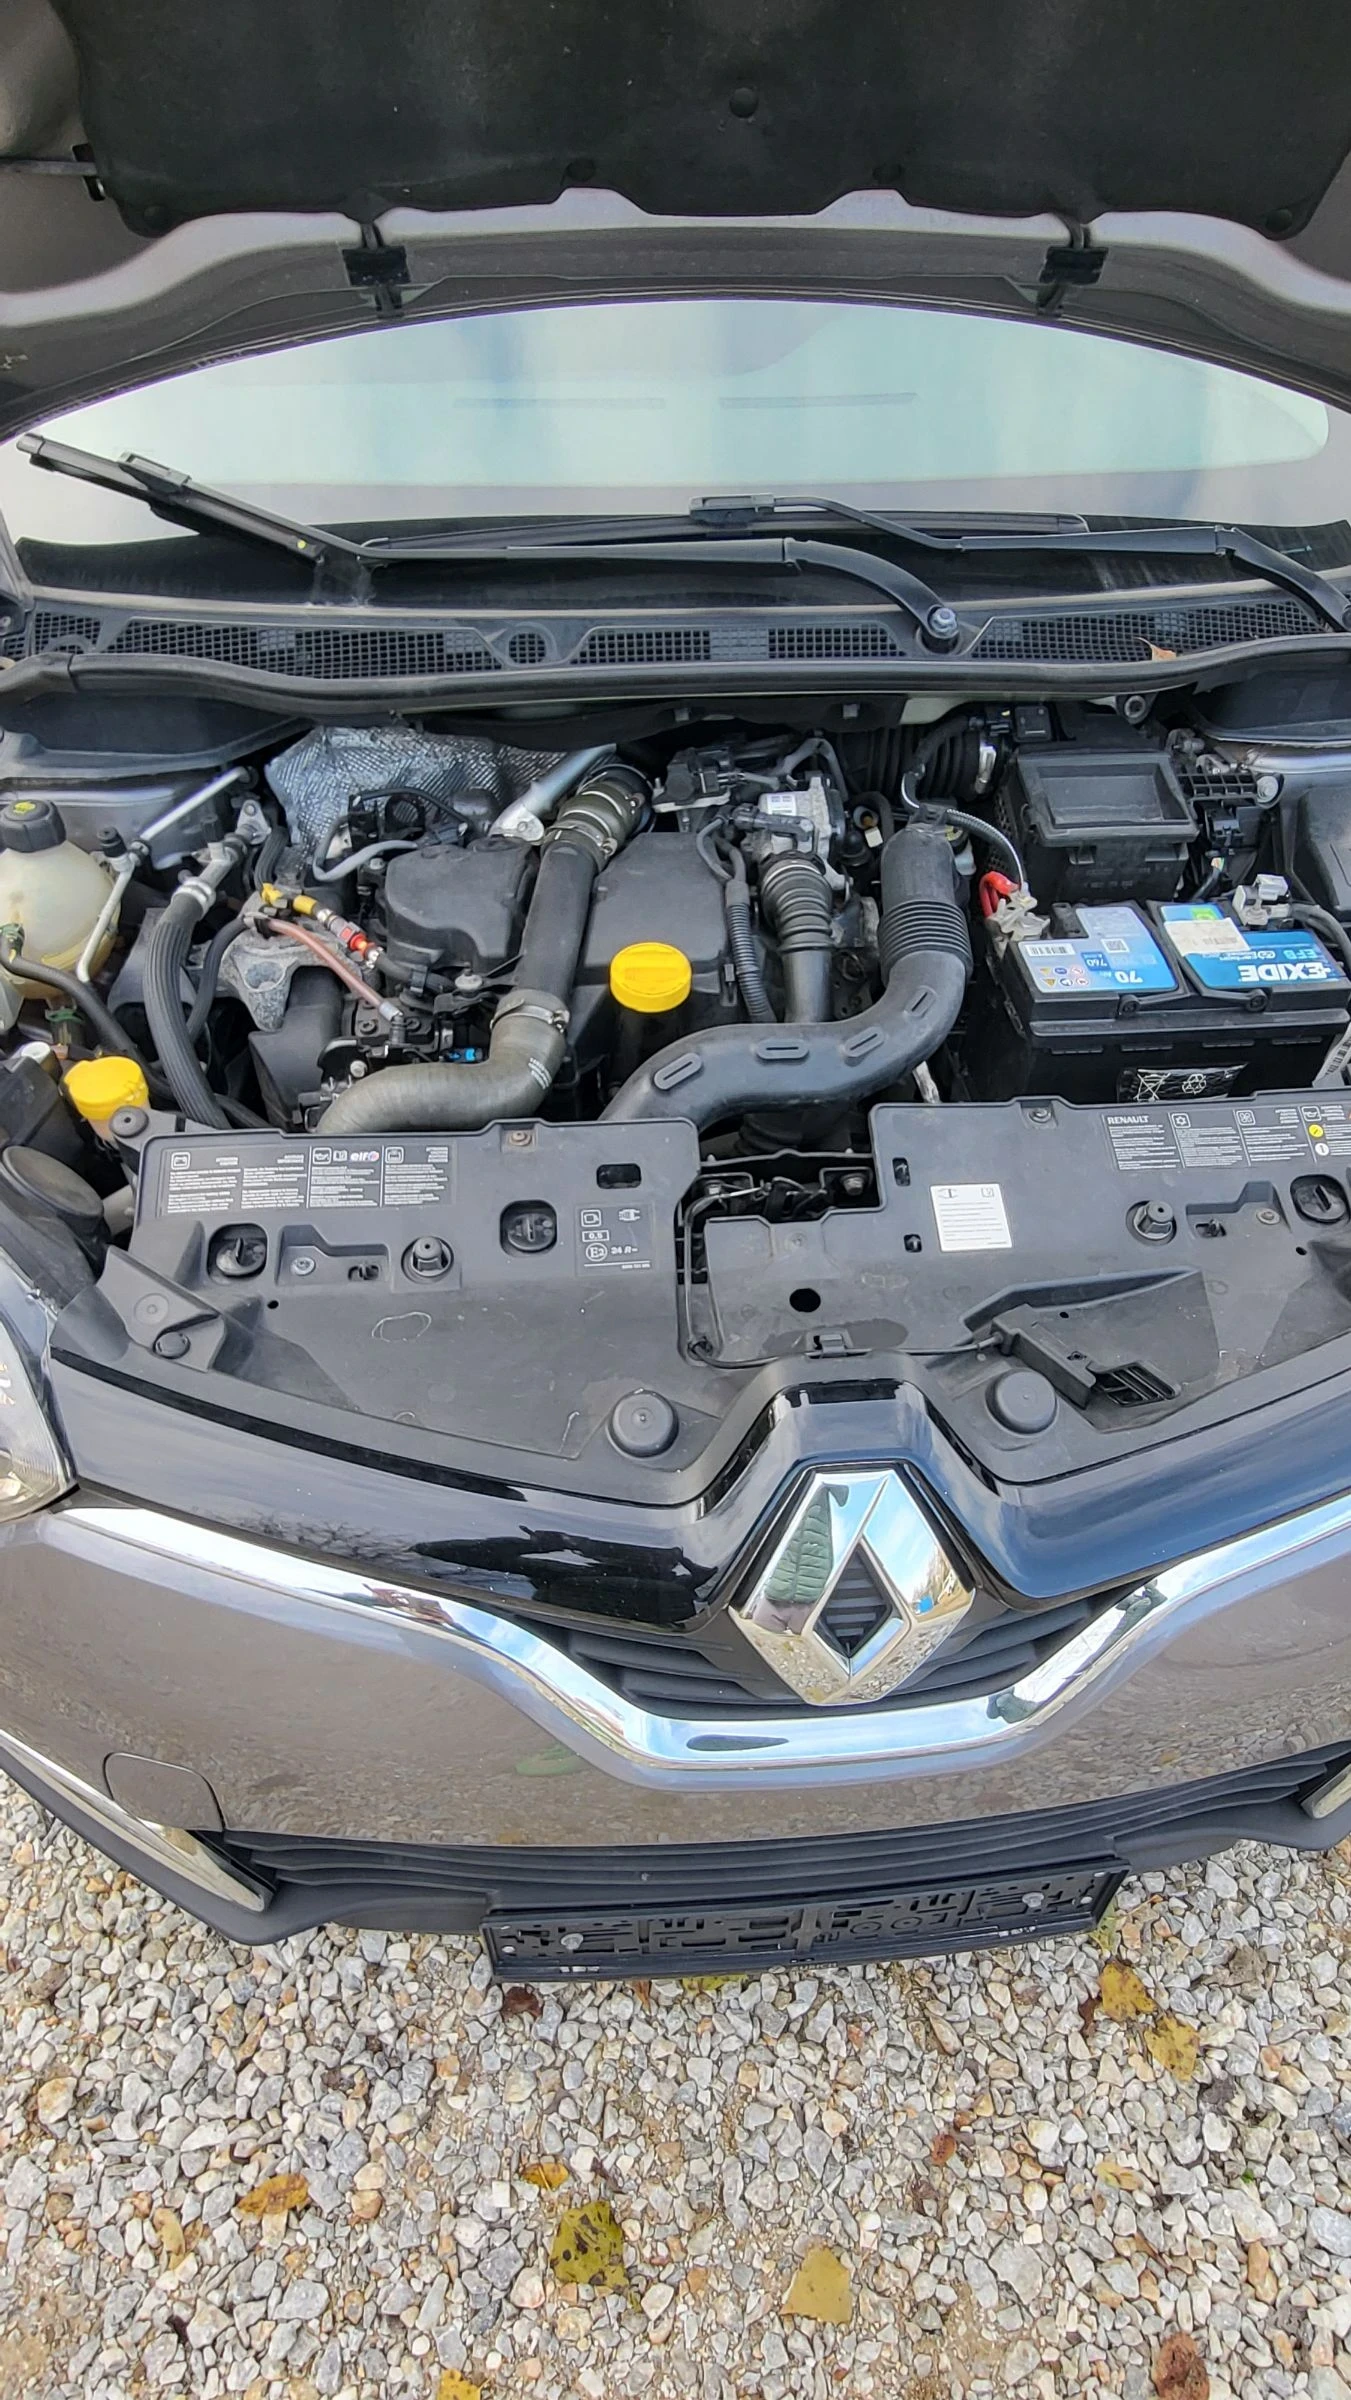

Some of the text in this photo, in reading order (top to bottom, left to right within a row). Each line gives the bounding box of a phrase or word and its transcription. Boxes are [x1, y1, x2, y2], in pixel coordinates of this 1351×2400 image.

[1283, 948, 1318, 960] EFB
[1086, 958, 1108, 967] 760
[1114, 970, 1144, 984] 70
[1238, 962, 1331, 982] EXIDE
[1107, 1114, 1149, 1125] RENAULT
[589, 1246, 605, 1258] E2
